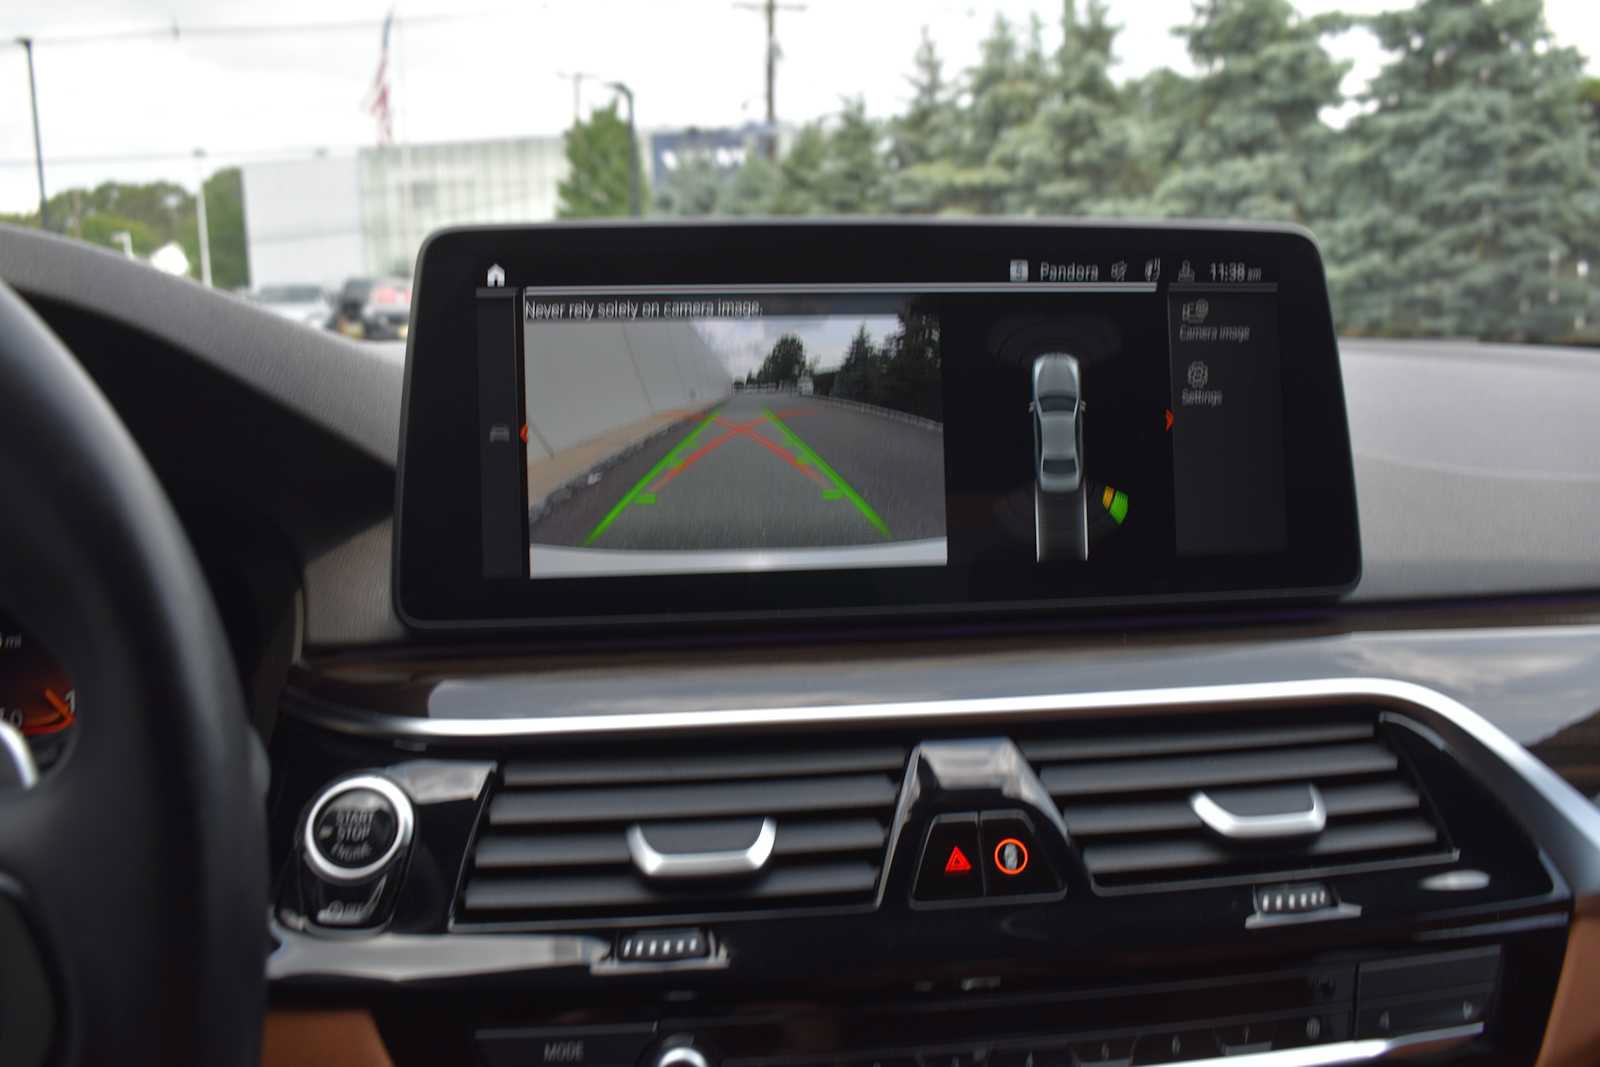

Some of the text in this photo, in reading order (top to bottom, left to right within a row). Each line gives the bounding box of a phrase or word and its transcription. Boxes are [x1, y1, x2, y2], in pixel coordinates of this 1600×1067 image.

[1041, 262, 1099, 281] Pandora
[1209, 262, 1246, 281] 11:38
[525, 300, 565, 319] Never
[569, 299, 594, 320] rely
[598, 298, 639, 320] solely
[642, 301, 660, 318] on
[663, 301, 714, 318] camera
[1179, 324, 1250, 344] Camera image
[1182, 388, 1223, 407] Settings
[336, 809, 375, 825] START
[338, 825, 372, 841] STOP
[544, 1040, 584, 1062] MODE
